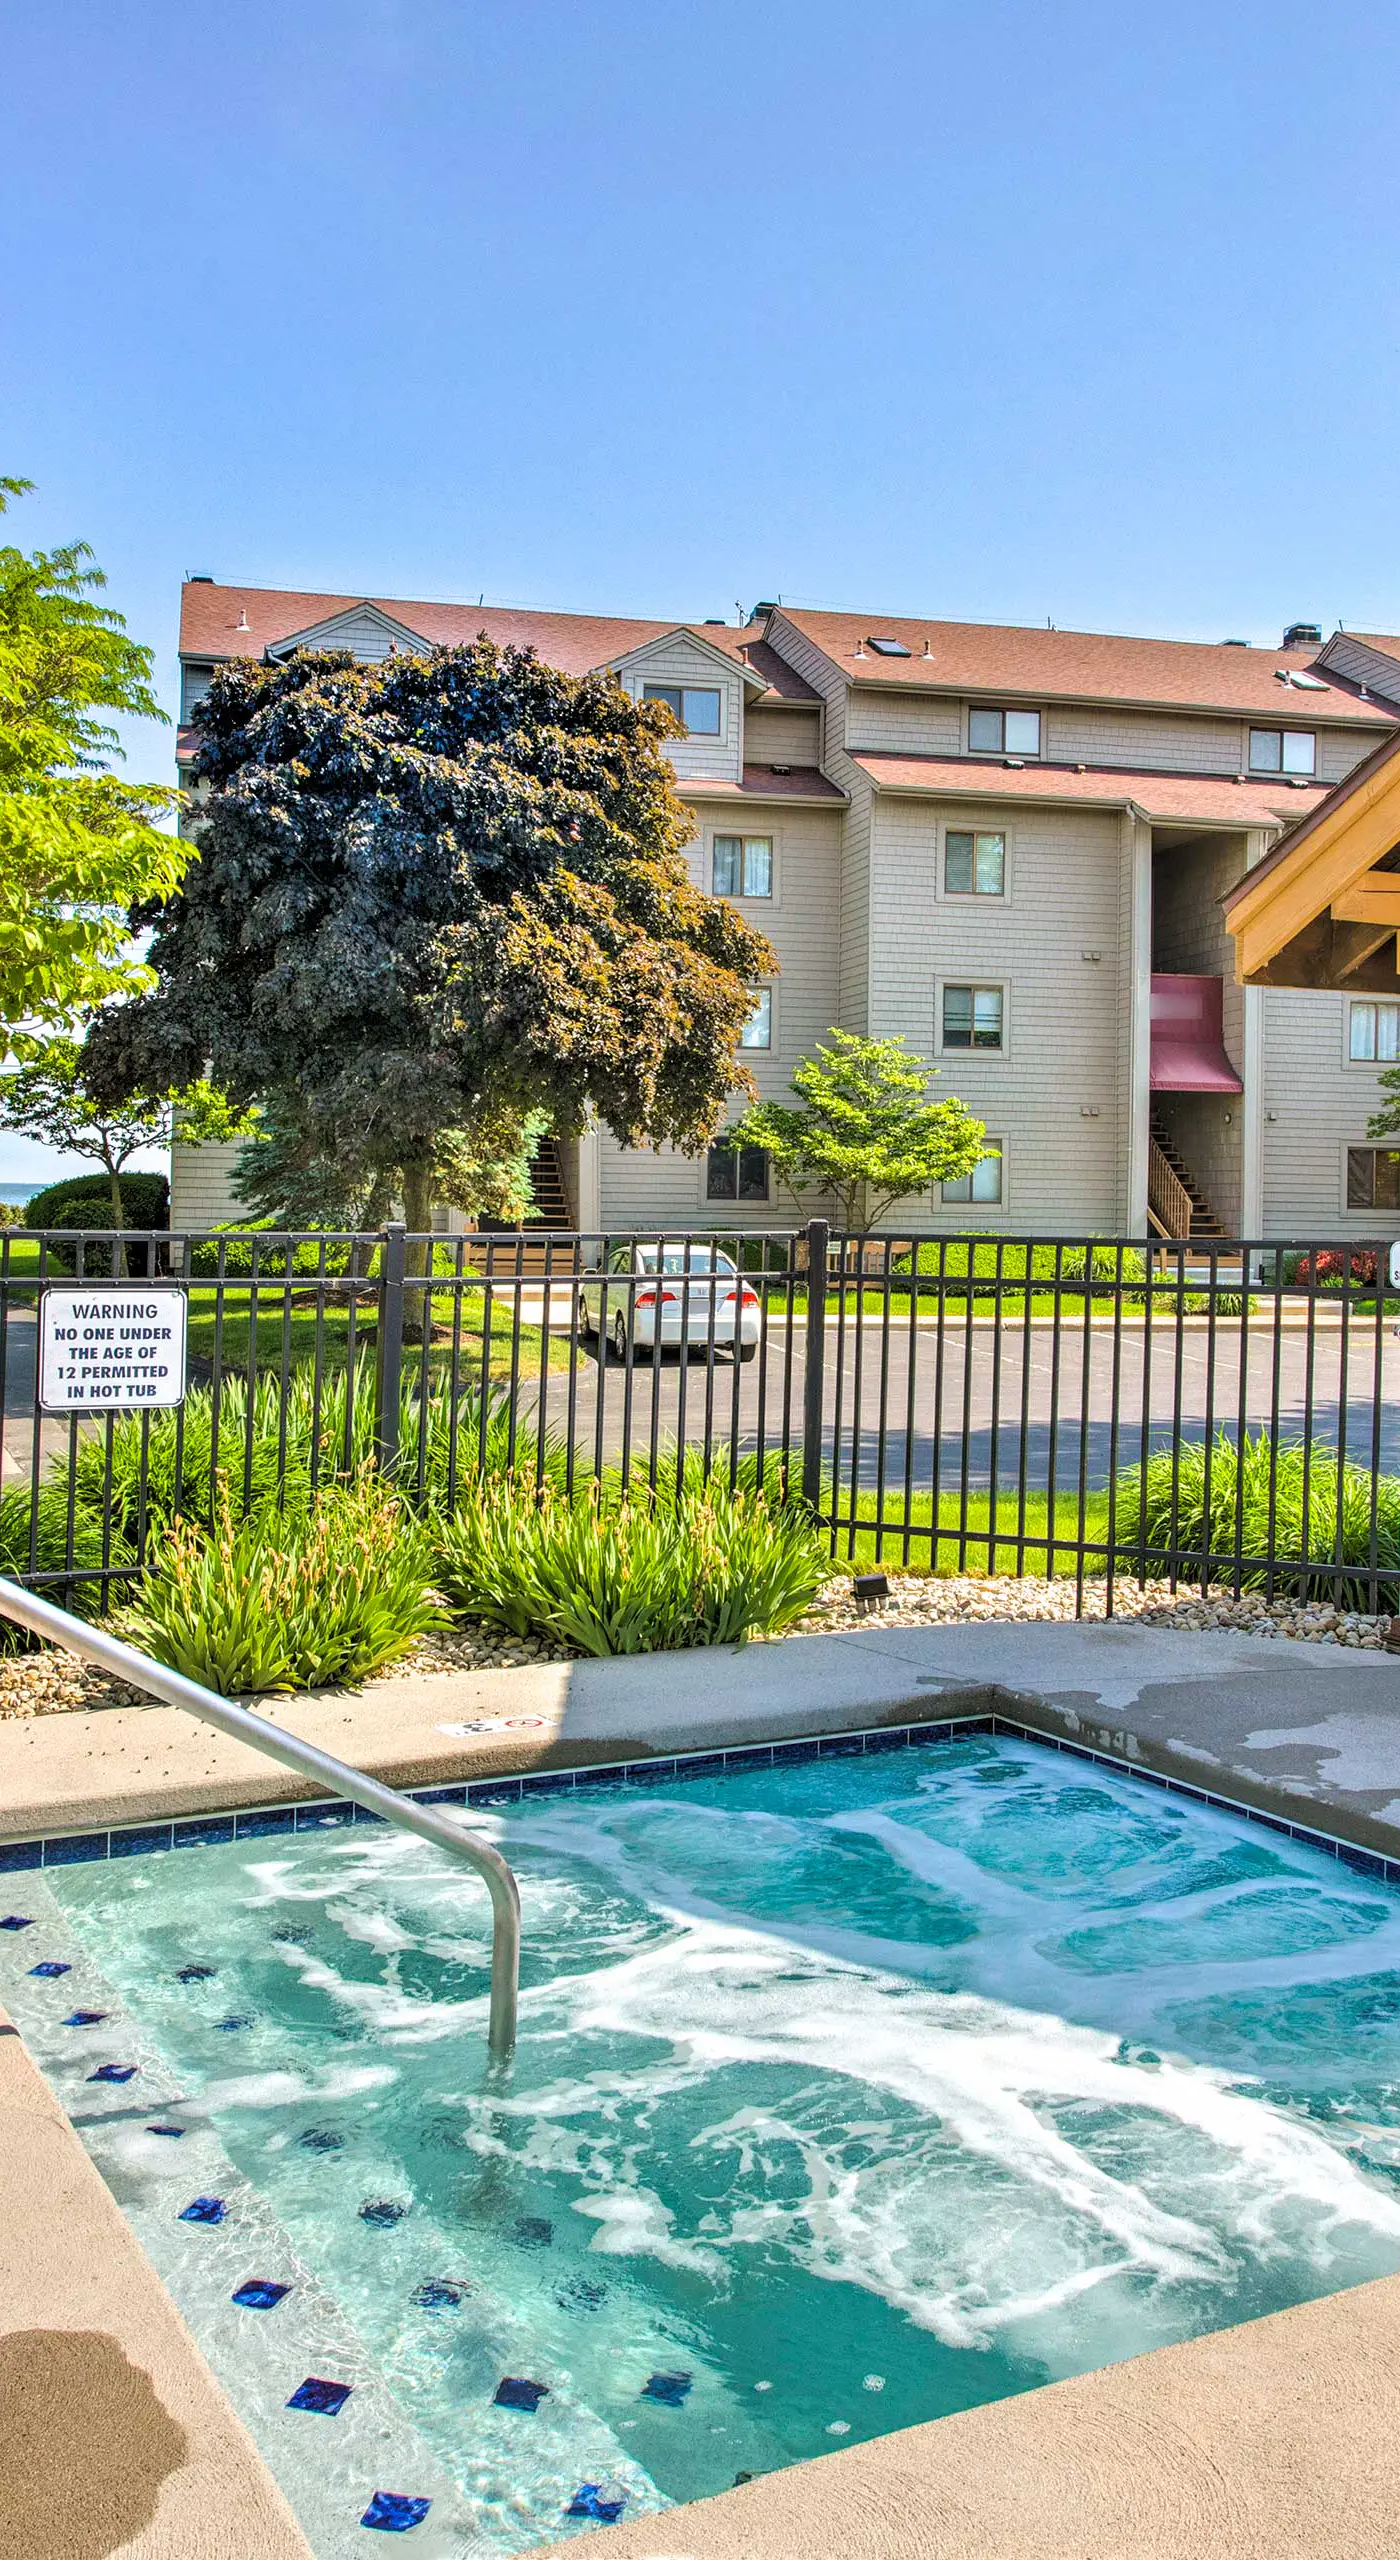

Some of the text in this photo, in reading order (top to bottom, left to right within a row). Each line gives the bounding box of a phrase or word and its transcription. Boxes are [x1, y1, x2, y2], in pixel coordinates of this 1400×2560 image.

[73, 1305, 157, 1318] WARNING
[55, 1328, 171, 1340] NO ONE UNDER
[69, 1347, 157, 1359] THE AGE OF
[58, 1366, 168, 1379] 12 PERMITTED
[68, 1385, 156, 1398] IN HOT TUB
